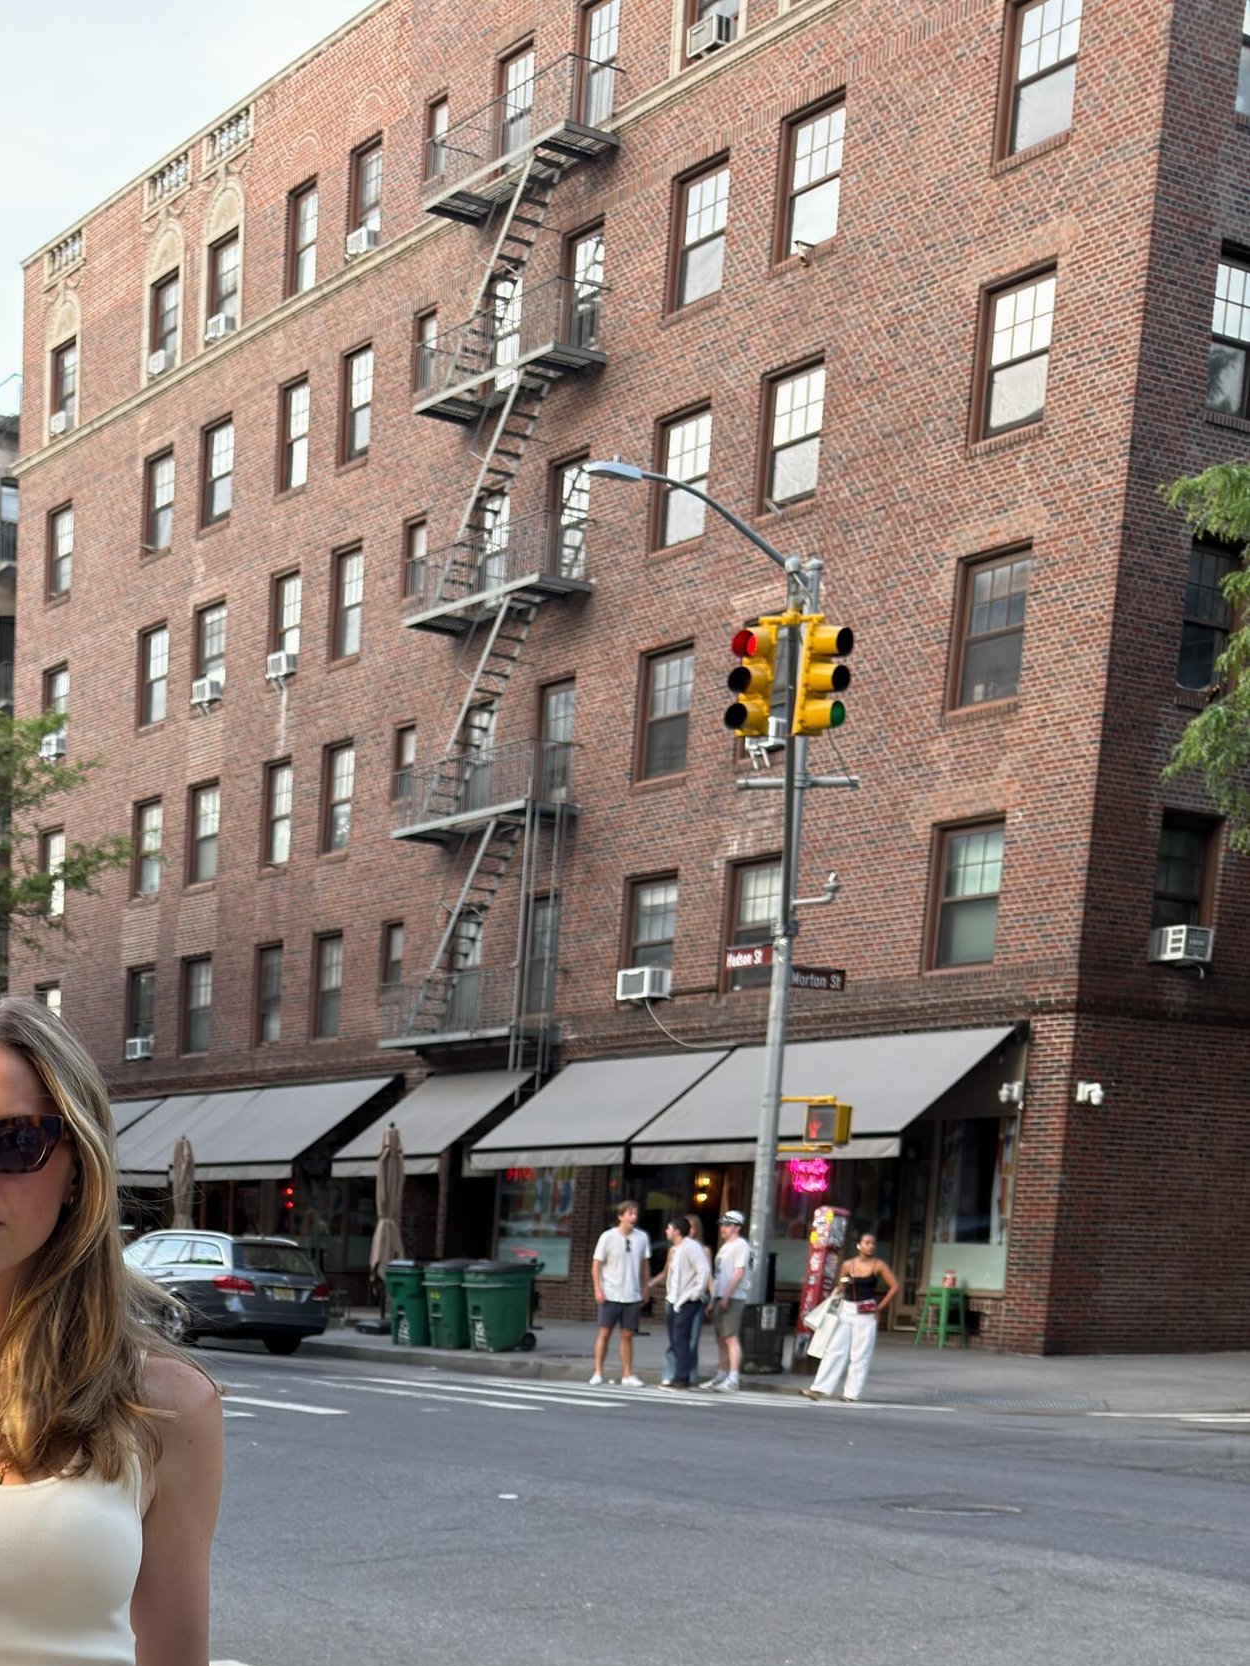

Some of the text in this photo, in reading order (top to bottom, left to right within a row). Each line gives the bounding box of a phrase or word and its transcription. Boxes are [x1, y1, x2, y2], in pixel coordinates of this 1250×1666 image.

[726, 950, 762, 968] Hudson St
[791, 971, 841, 989] Morton St
